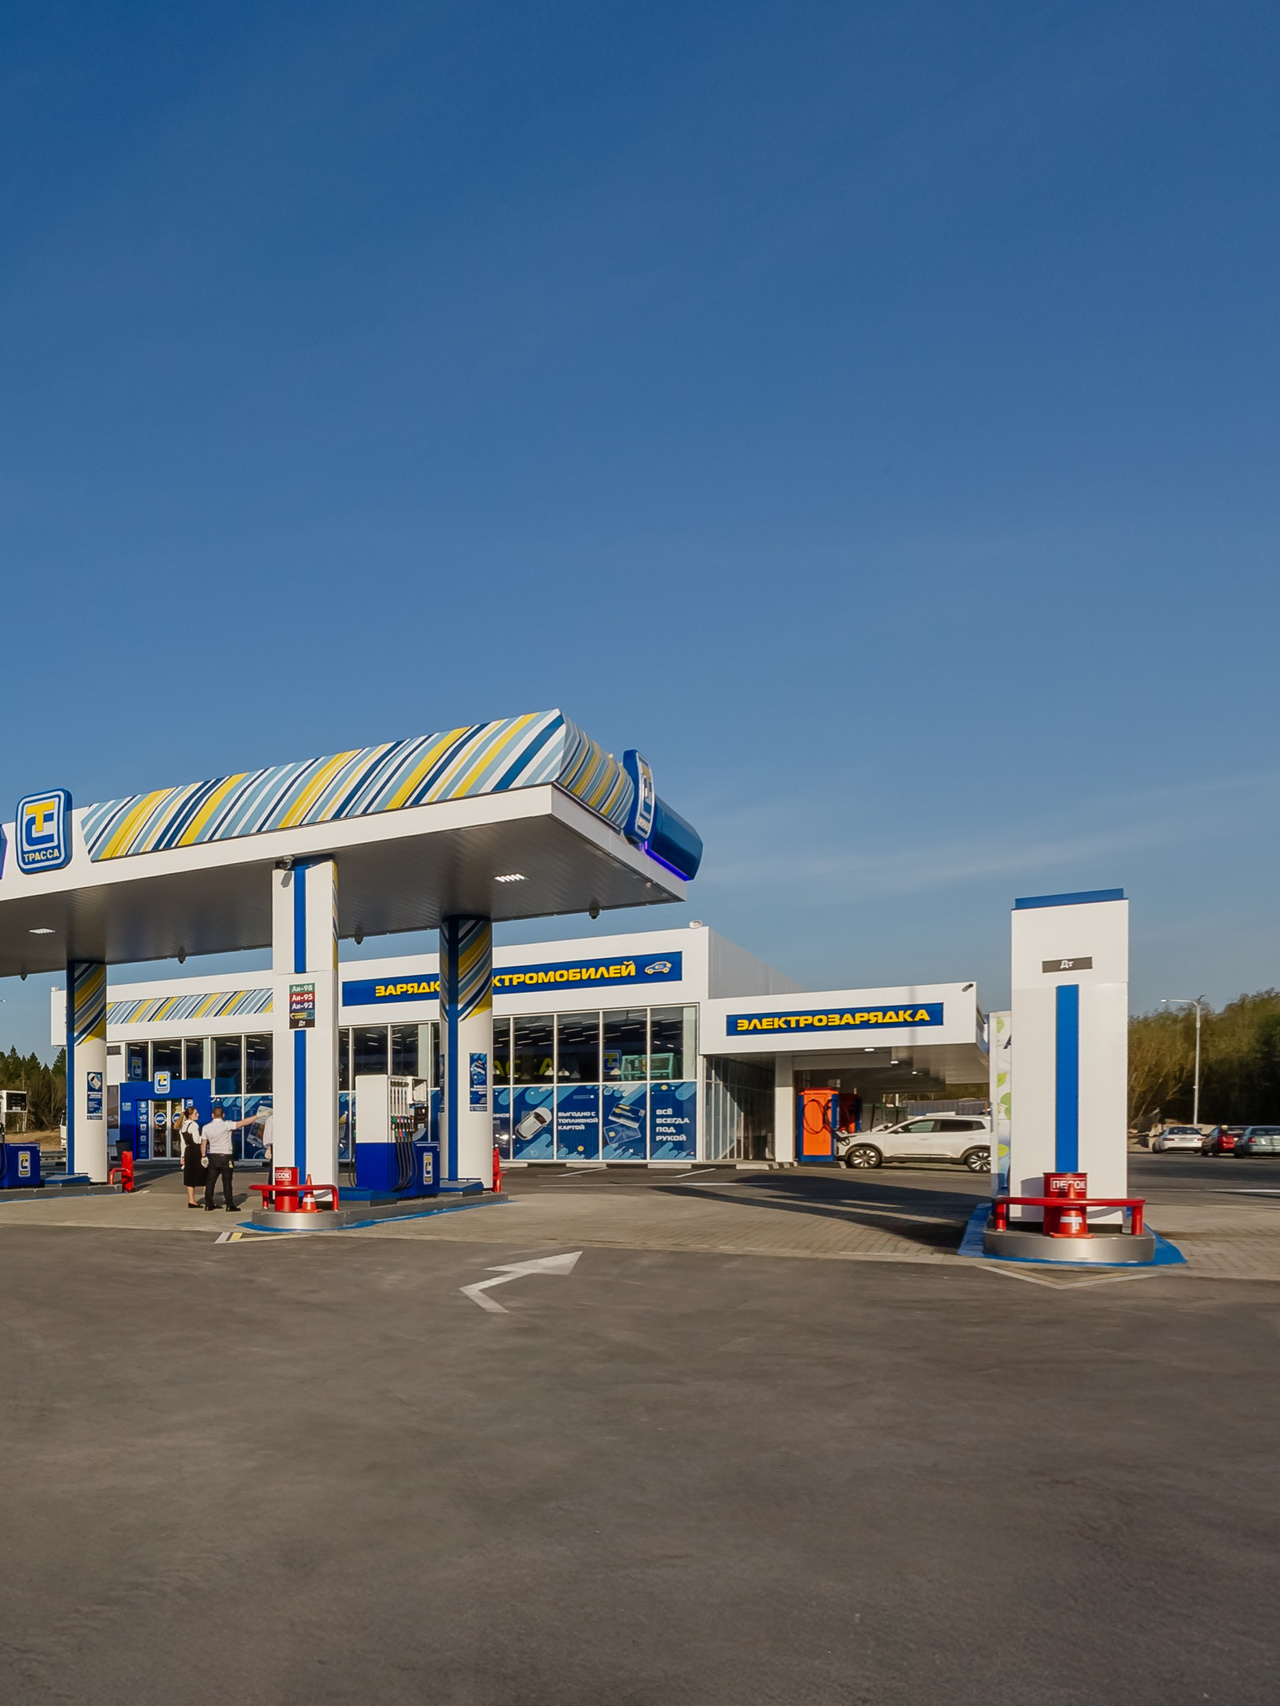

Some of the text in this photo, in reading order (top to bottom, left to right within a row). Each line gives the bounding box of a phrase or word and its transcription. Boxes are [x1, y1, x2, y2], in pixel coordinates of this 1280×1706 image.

[23, 849, 60, 862] ТРАССА
[375, 961, 635, 997] ЗАРЯДК КТРОМОБИЛЕЙ
[737, 1009, 930, 1031] ЭЛЕКТРОЗАРЯДКА
